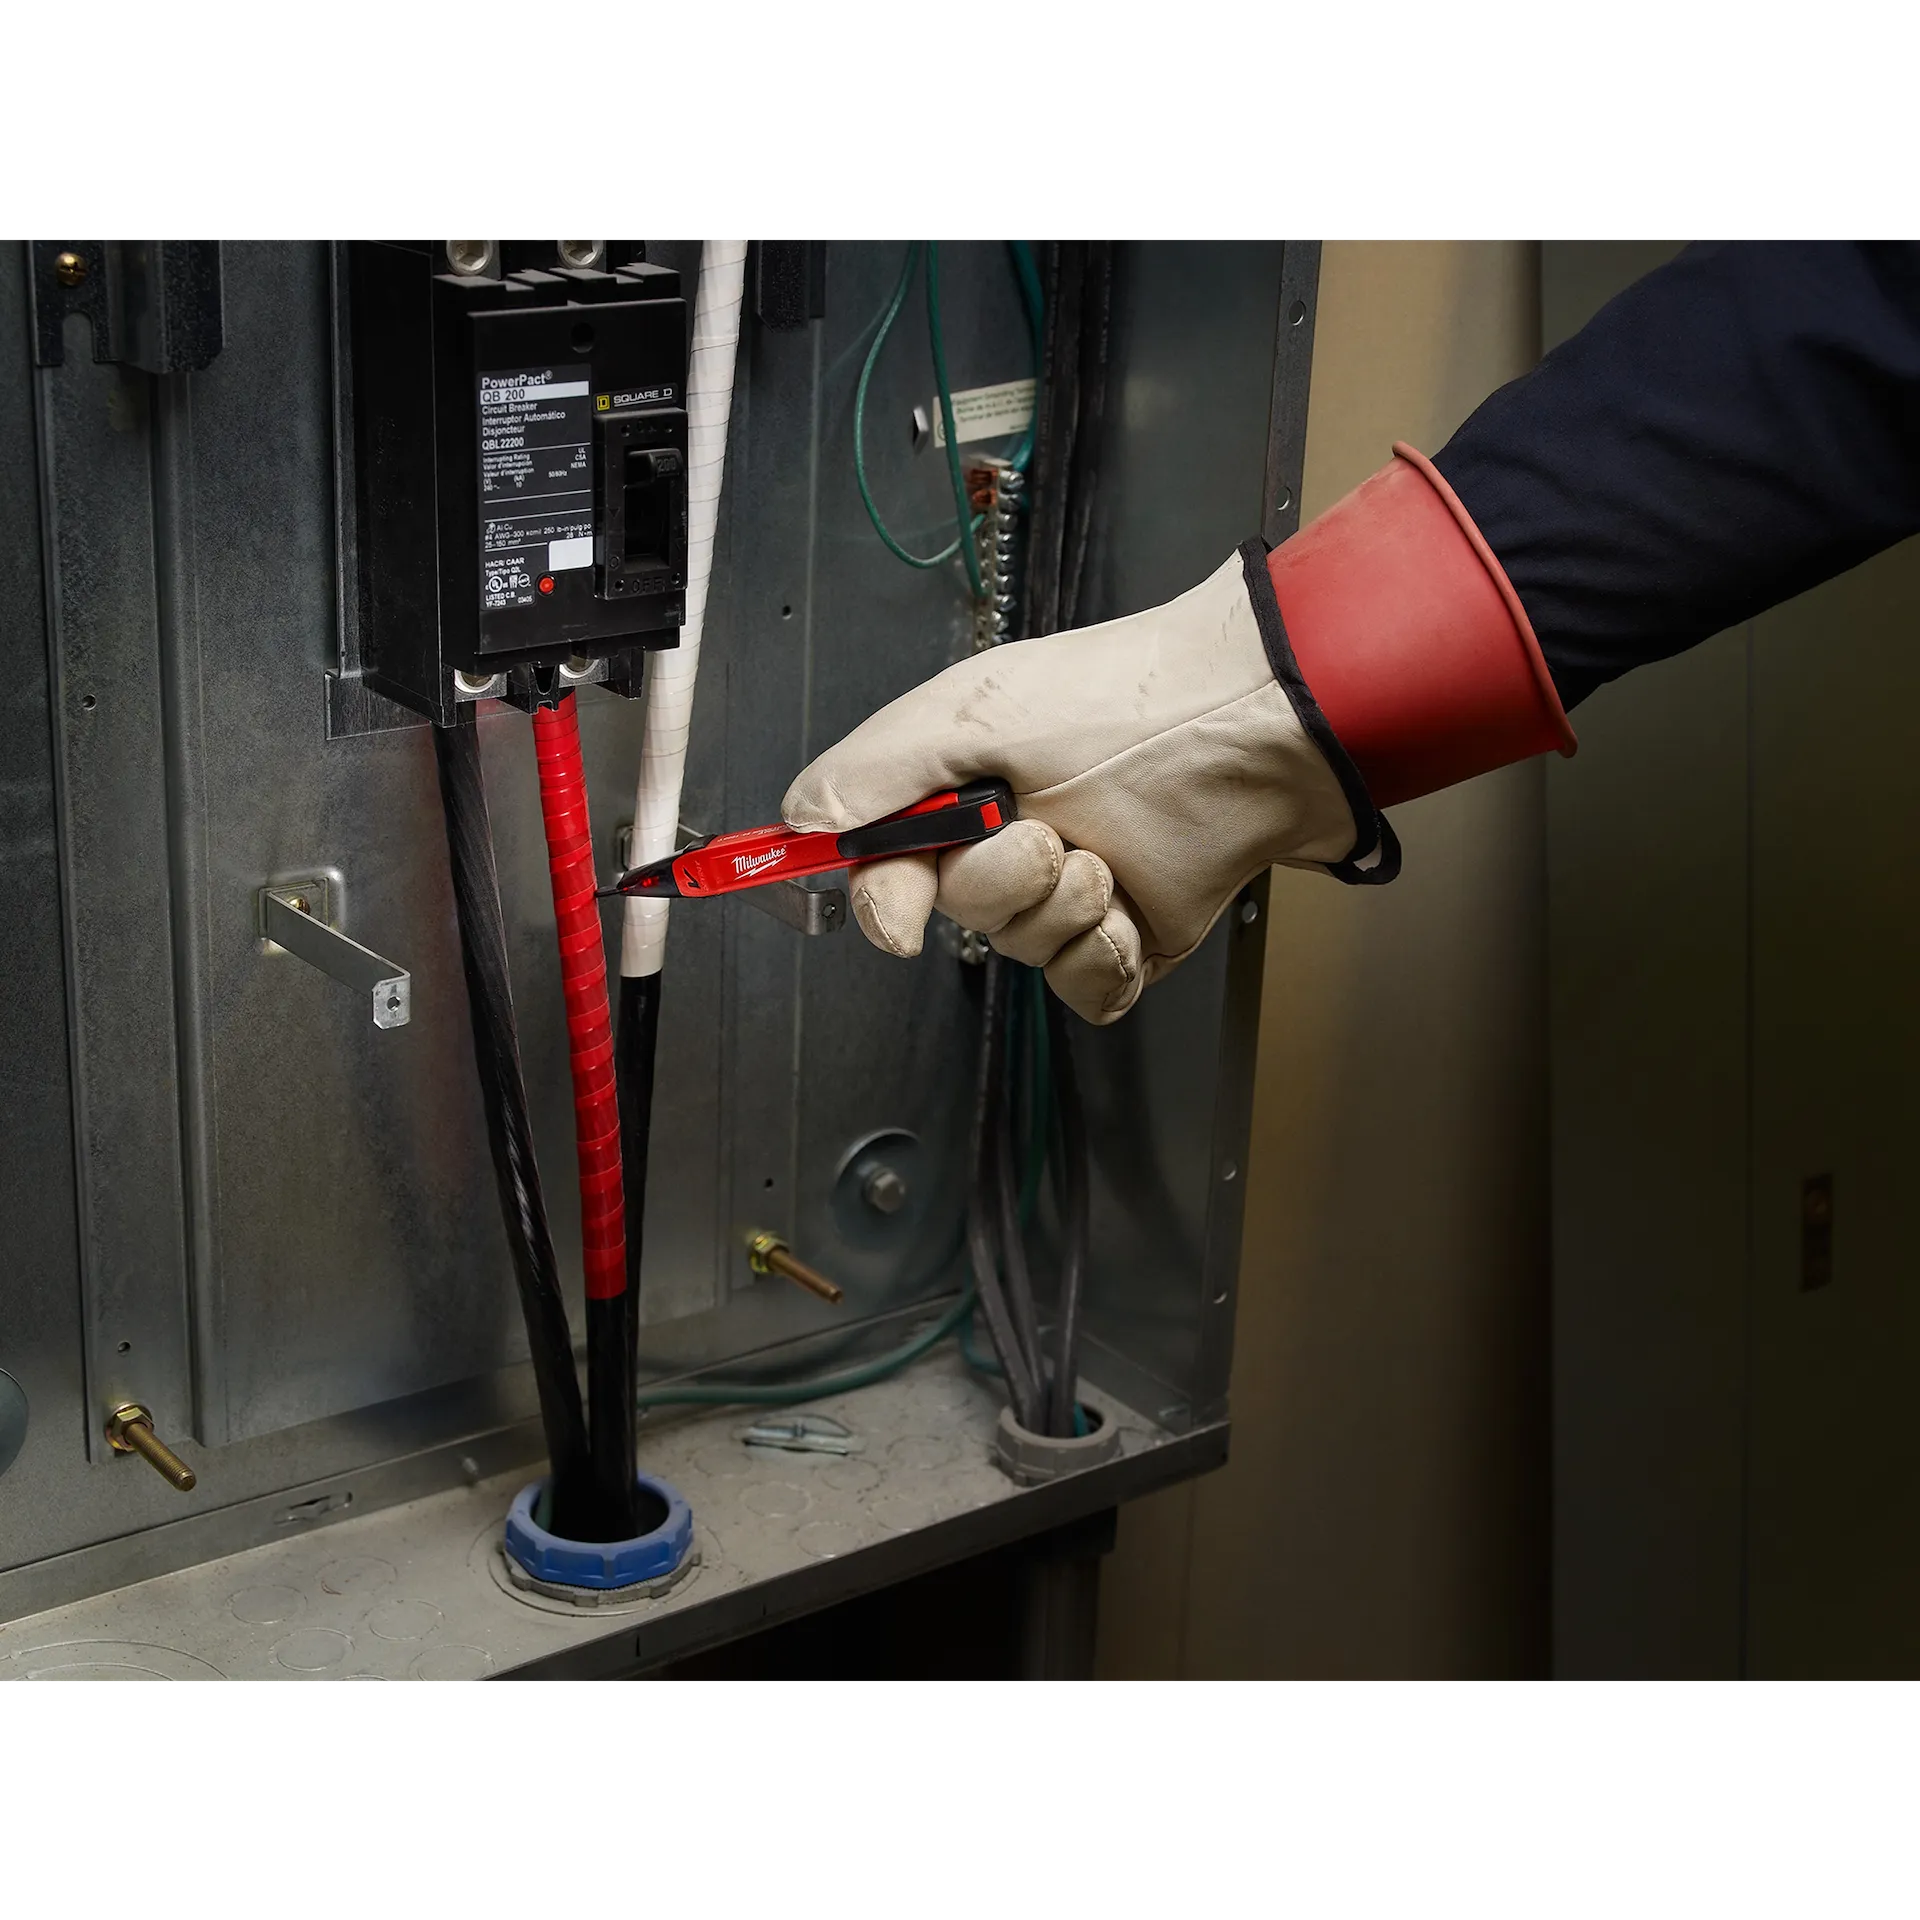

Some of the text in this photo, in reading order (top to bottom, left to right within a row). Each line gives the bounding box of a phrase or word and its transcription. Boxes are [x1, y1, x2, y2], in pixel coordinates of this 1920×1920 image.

[482, 389, 525, 403] QB 200
[613, 388, 672, 404] SQUARE D
[482, 403, 537, 415] Circuit Breaker
[482, 411, 566, 426] Interruptor Automático
[482, 425, 525, 437] Disjoncteur
[482, 437, 524, 450] QBL22200
[731, 848, 786, 874] Milwaukee
